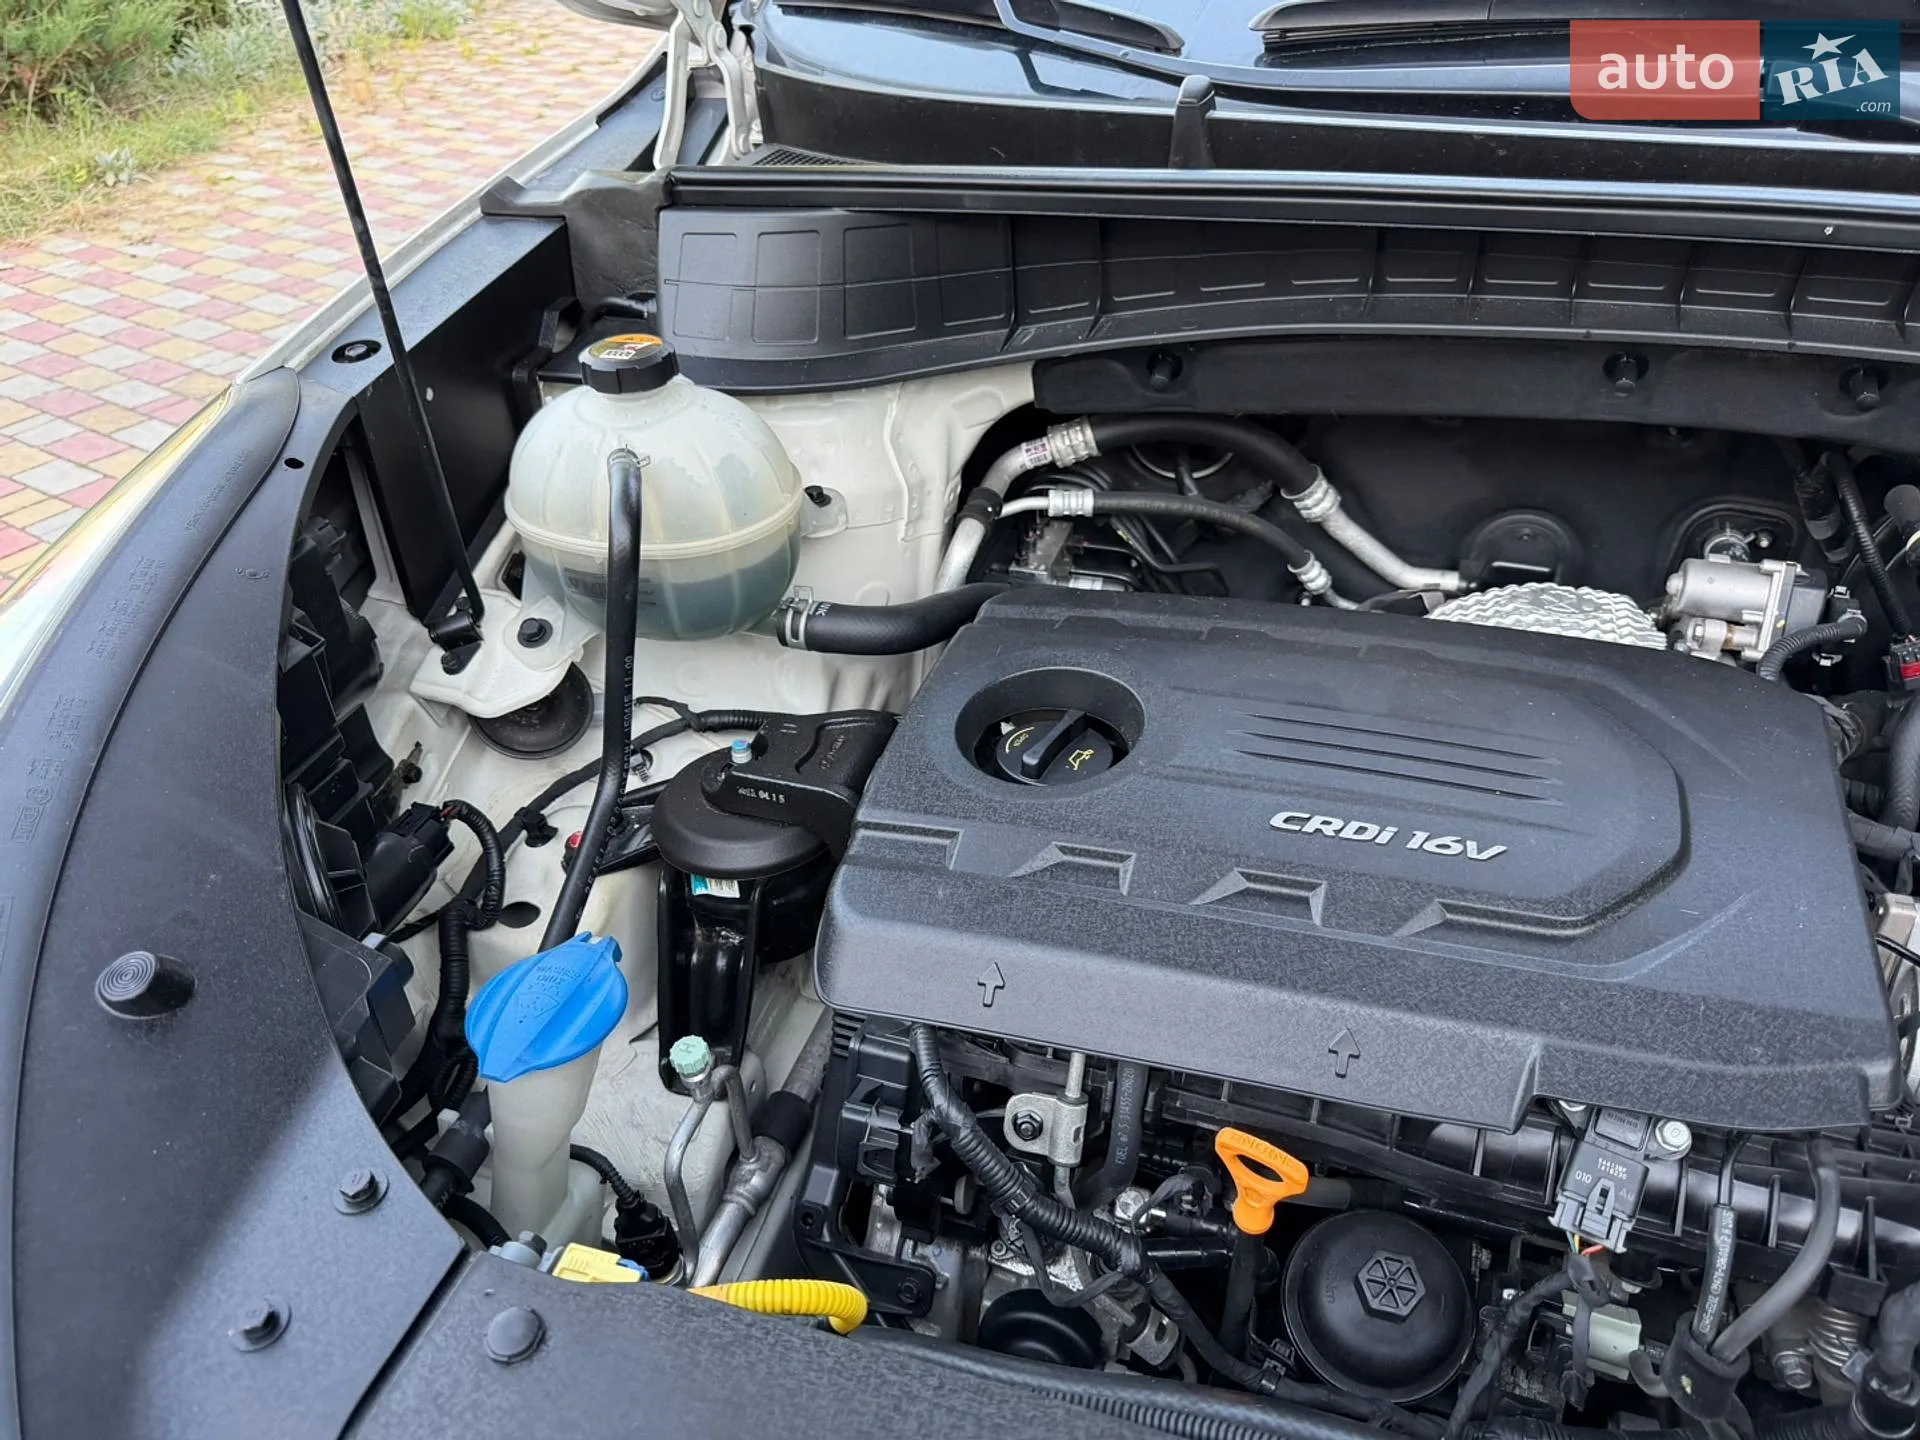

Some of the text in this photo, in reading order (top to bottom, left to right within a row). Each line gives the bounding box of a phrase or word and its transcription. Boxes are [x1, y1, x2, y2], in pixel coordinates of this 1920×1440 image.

[1269, 811, 1507, 861] CRDi 16V
[1574, 1170, 1592, 1184] 010
